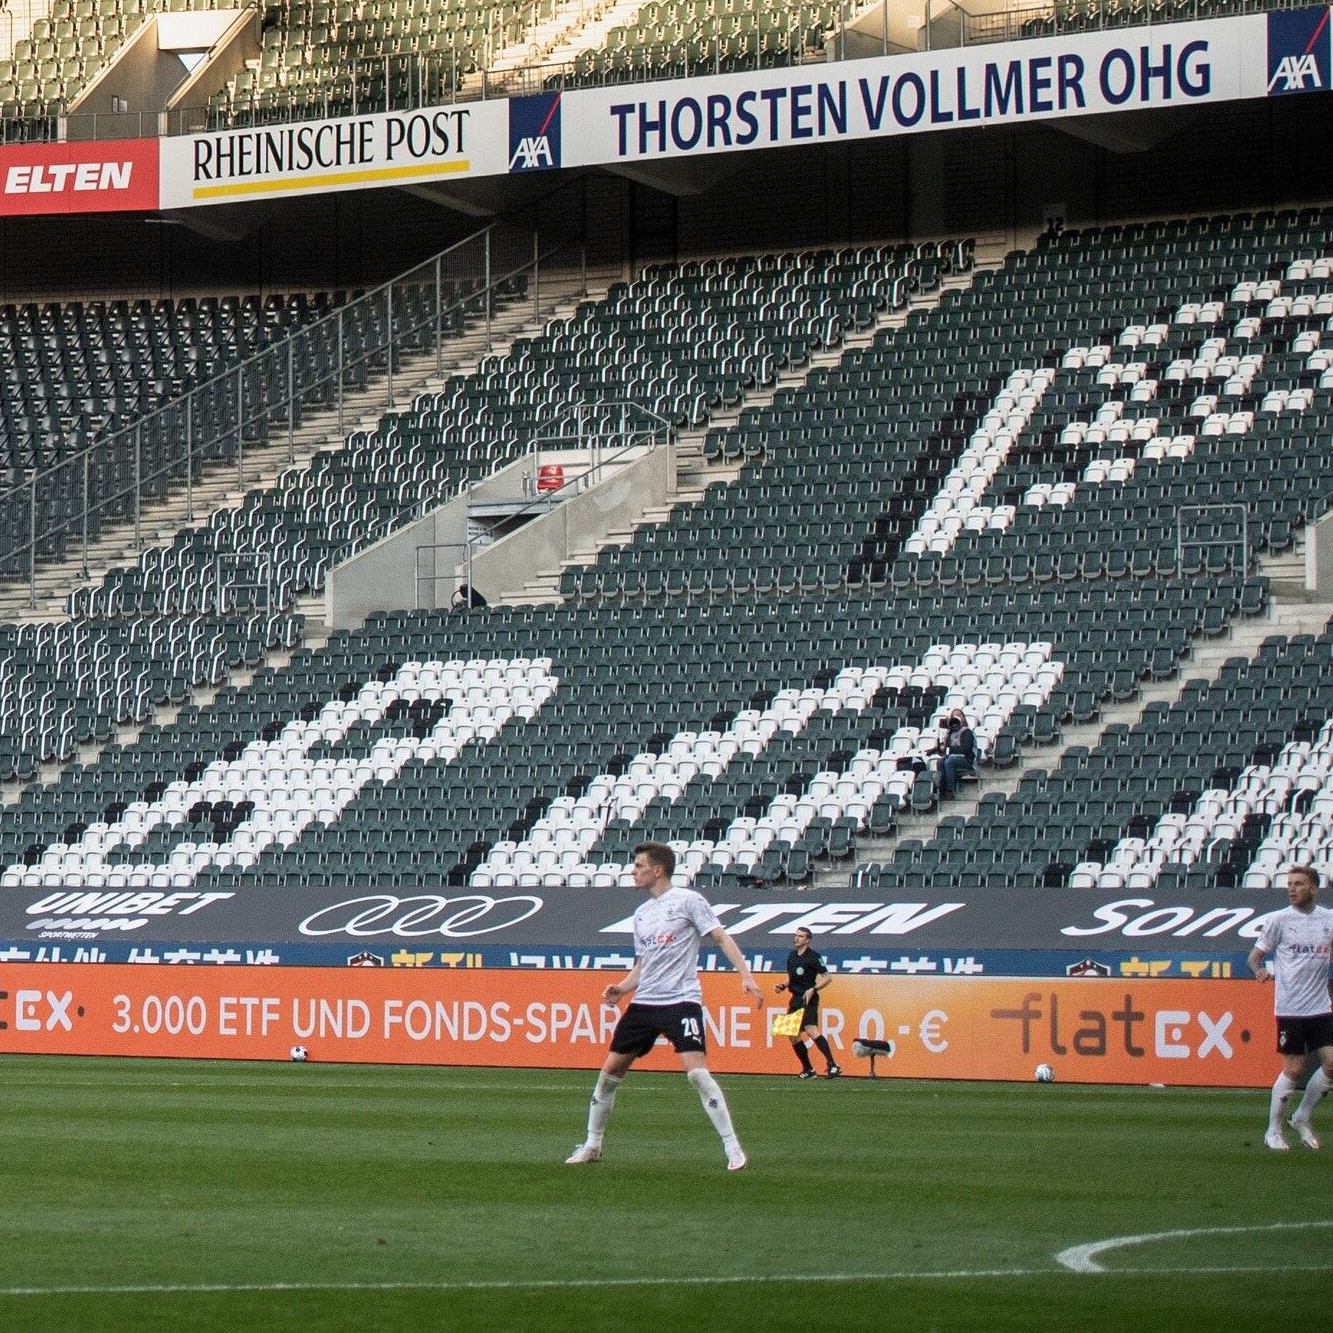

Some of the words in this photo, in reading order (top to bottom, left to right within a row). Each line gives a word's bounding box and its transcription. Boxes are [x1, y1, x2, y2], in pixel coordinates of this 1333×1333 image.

[1267, 53, 1323, 93] AXA
[609, 80, 847, 157] THORSTEN
[859, 52, 1086, 131] VOLLMER
[1099, 39, 1211, 106] OHG
[193, 119, 375, 181] RHEINISCHE
[386, 109, 471, 161] POST
[509, 133, 553, 169] AXA
[4, 161, 133, 195] ELTEN
[25, 892, 236, 915] UNIBET
[112, 994, 207, 1035] 3.000
[219, 996, 281, 1036] ETF
[292, 997, 371, 1040] UND
[767, 1005, 845, 1051] FR
